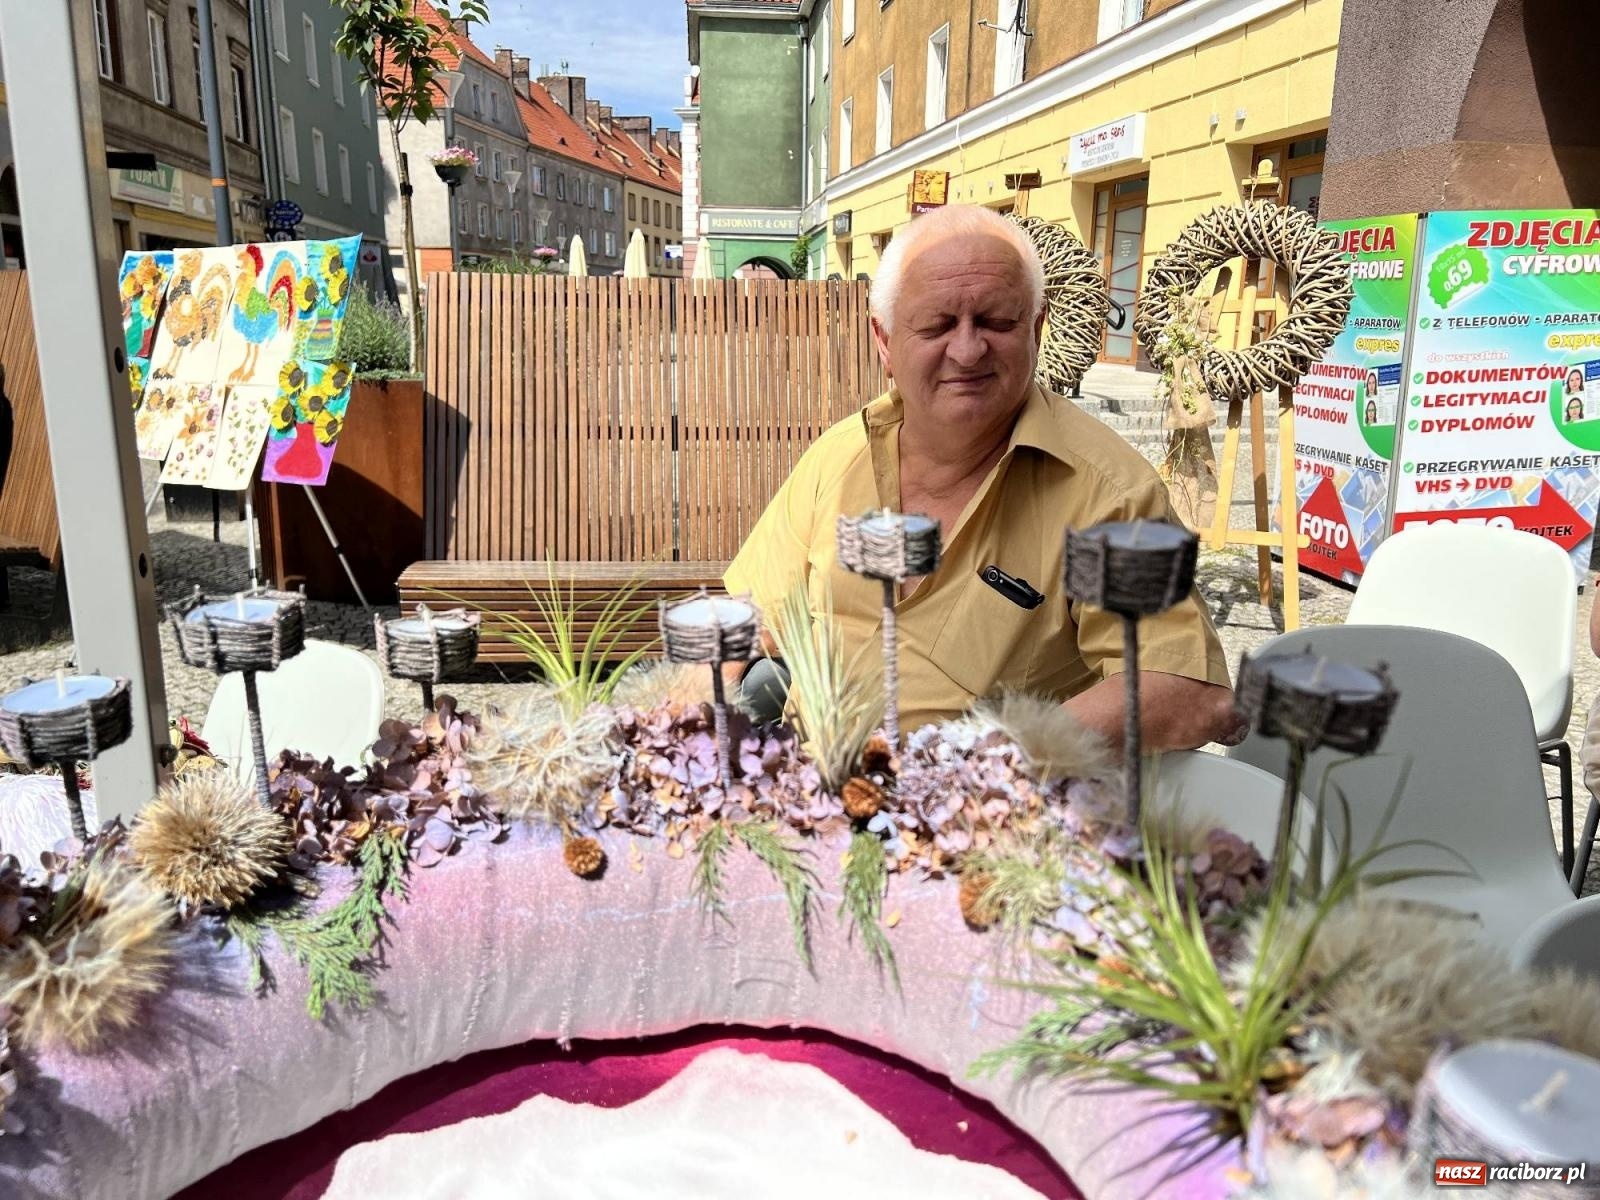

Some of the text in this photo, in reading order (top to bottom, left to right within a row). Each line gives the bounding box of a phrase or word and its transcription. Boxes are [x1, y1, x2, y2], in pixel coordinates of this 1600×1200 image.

[711, 218, 762, 229] RISTORANTE
[765, 219, 772, 228] &
[1336, 227, 1396, 258] JĘCIA
[1467, 220, 1600, 253] ZDJĘCIA
[1350, 260, 1404, 279] FROWE
[1502, 254, 1600, 276] CYFROW
[1433, 318, 1442, 329] Z
[1448, 314, 1530, 328] TELEFONÓW
[1544, 313, 1600, 325] APARAT
[1356, 338, 1400, 353] expres
[1548, 333, 1600, 350] expr
[1309, 364, 1368, 380] UMENTÓW
[1425, 363, 1568, 385] DOKUMENTÓW
[1294, 384, 1355, 402] EGITYMACJI
[1423, 390, 1547, 408] LEGITYMACJI
[1295, 405, 1348, 424] YPLOMÓW
[1421, 413, 1535, 433] DYPLOMÓW
[1295, 443, 1352, 464] ZEGRYWANIE
[1355, 456, 1388, 472] KASET
[1416, 455, 1600, 475] PRZEGRYWANIE KASET
[1313, 463, 1335, 478] DVD
[1415, 476, 1513, 493] VHS DVD
[1300, 512, 1349, 549] FOTO
